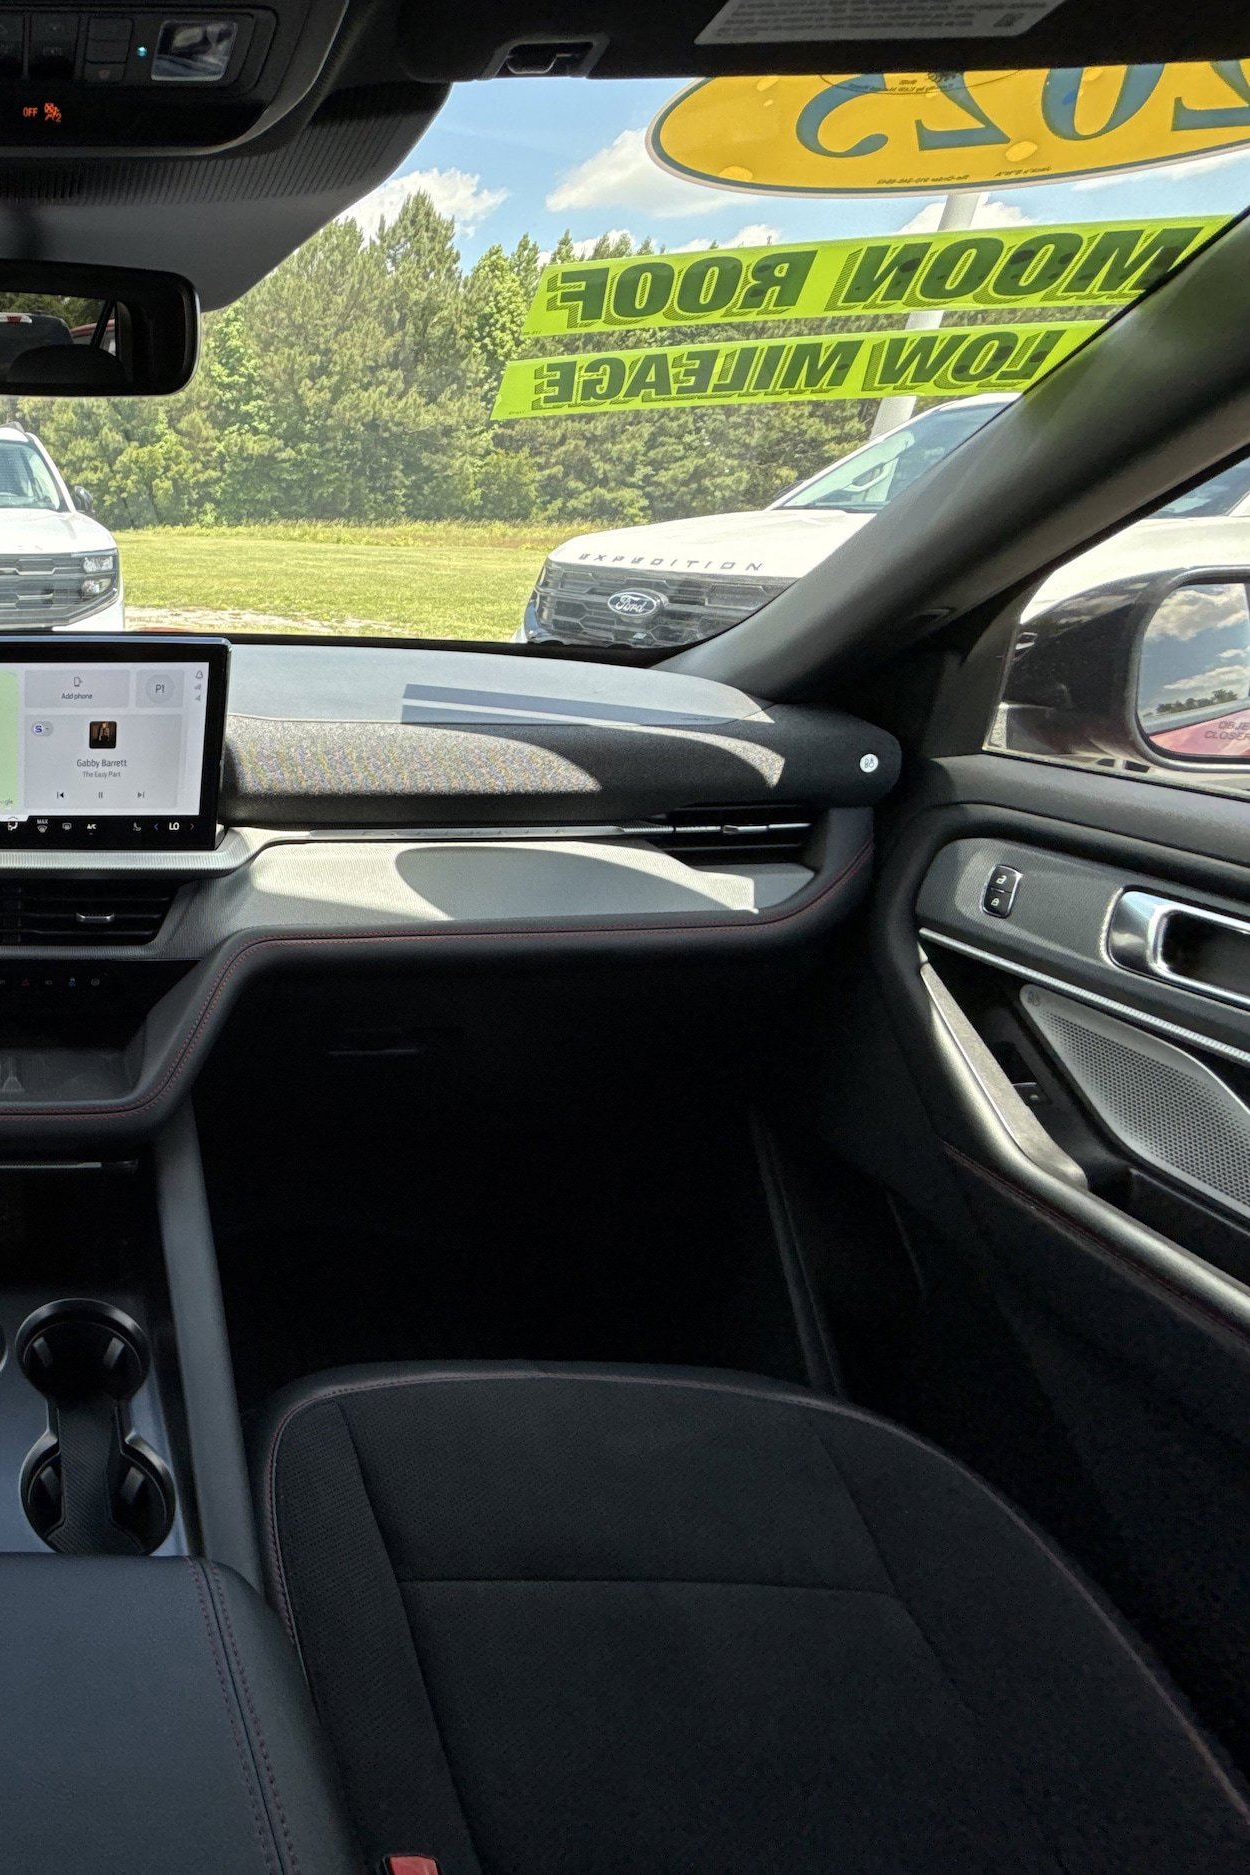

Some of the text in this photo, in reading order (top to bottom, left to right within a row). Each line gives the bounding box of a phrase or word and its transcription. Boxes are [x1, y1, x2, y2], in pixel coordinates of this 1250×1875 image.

[22, 107, 38, 117] OFF
[578, 553, 763, 571] EXPEDITION
[155, 684, 165, 693] P1
[61, 692, 93, 701] Add phone
[76, 759, 128, 768] Gabby Barrett
[94, 771, 107, 779] Easy
[168, 822, 180, 831] LO
